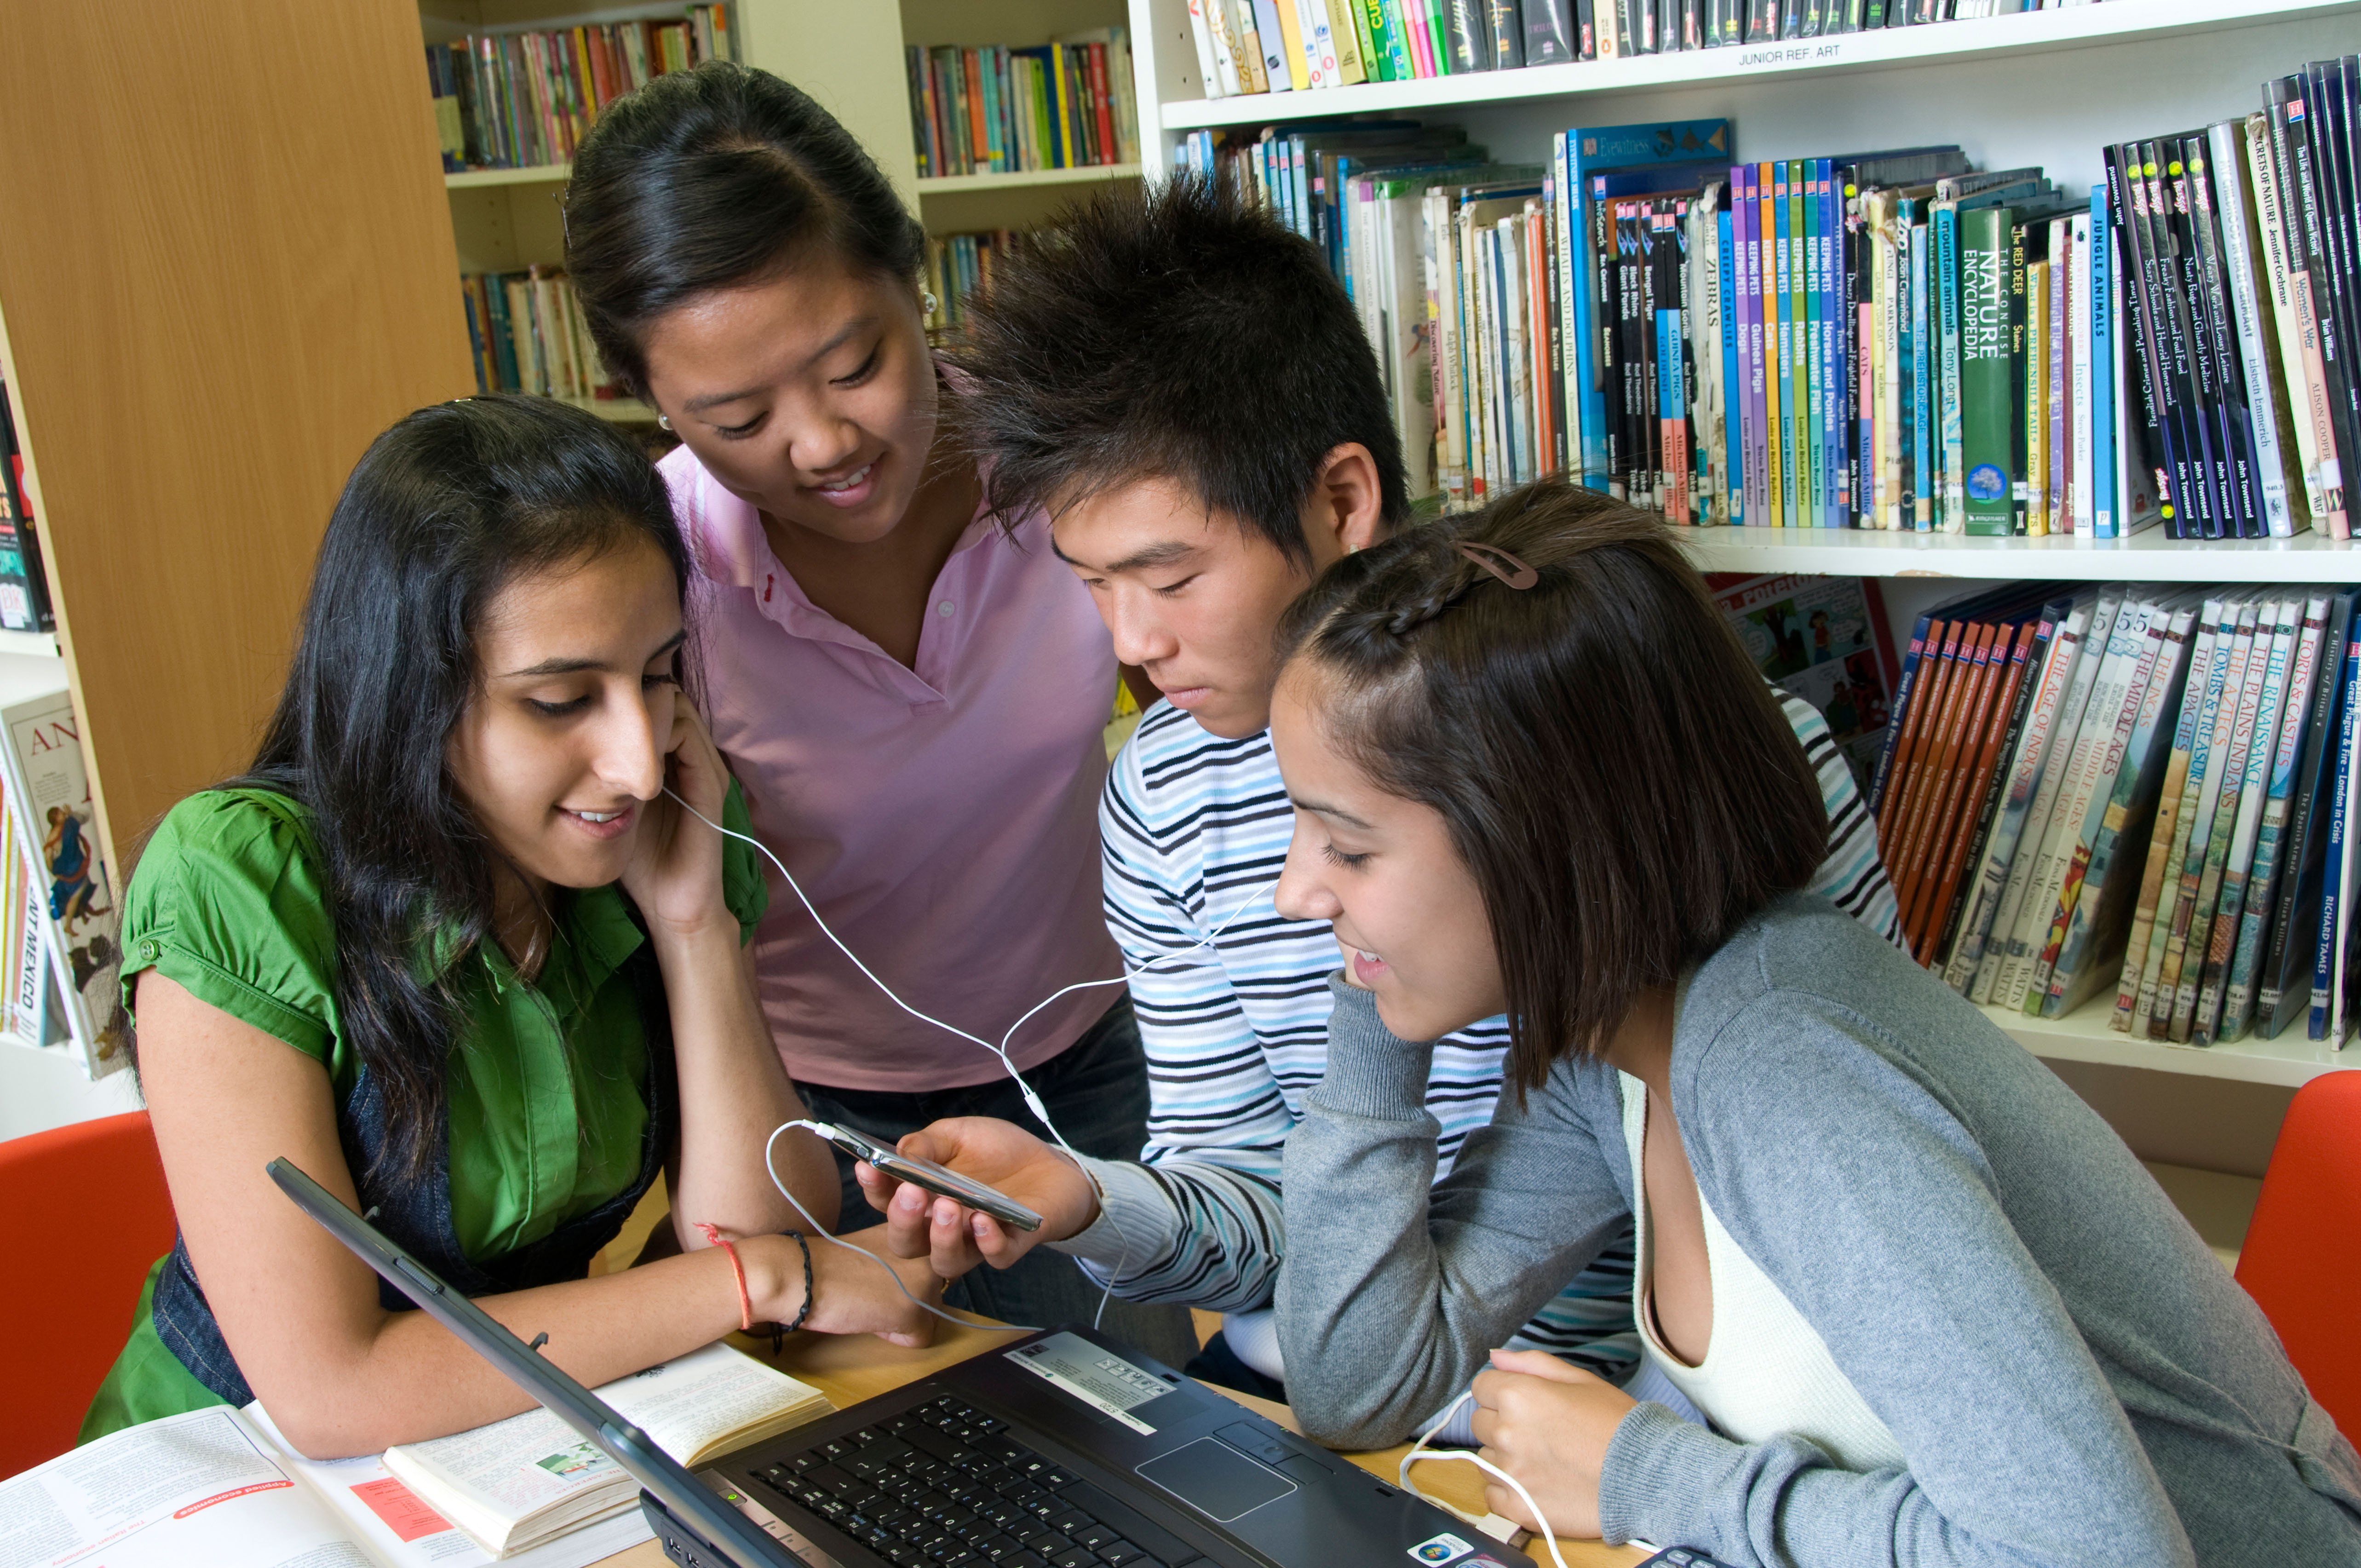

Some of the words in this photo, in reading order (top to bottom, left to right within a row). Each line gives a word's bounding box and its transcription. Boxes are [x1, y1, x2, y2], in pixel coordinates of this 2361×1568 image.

[1739, 51, 1782, 66] JUNIOR
[1787, 48, 1813, 61] REF.
[1816, 45, 1840, 57] ART
[2311, 111, 2321, 147] HEINEMANN
[1569, 139, 1579, 183] EYEWITNESS
[1601, 138, 1649, 160] Eyewitness
[2108, 166, 2120, 207] Townsend
[2260, 172, 2271, 186] OF
[1571, 184, 1580, 210] SHARK
[2263, 187, 2276, 225] NATURE
[2115, 208, 2124, 225] John
[1896, 216, 1911, 251] Zoo
[2094, 220, 2102, 270] JUNGLE
[2269, 229, 2281, 265] Jennifer
[2309, 233, 2319, 256] Victoria
[1560, 236, 1570, 280] WHALES
[1722, 240, 1730, 283] CREEPY
[1735, 241, 1745, 275] KEEPING
[1748, 241, 1759, 275] KEEPING
[1899, 255, 1908, 276] Joan
[1942, 221, 1953, 282] mountain
[1999, 248, 2008, 277] THE
[2013, 247, 2023, 266] RED
[1620, 265, 1628, 289] Giant
[1644, 265, 1652, 297] Bengal
[1679, 264, 1689, 306] Mountain
[1736, 276, 1746, 295] PETS
[1750, 276, 1760, 295] PETS
[2013, 269, 2023, 295] DEER
[2145, 258, 2154, 283] Scary
[2184, 257, 2195, 283] Nasty
[2274, 265, 2287, 307] Cochrane
[1562, 285, 1571, 312] AND
[1630, 289, 1638, 317] Rhino
[1707, 258, 1718, 327] ZEBRAS
[2029, 273, 2037, 301] What
[2128, 280, 2139, 307] Times
[2149, 283, 2161, 314] Schools
[2188, 284, 2199, 303] Bugs
[2296, 277, 2313, 327] Women's
[1620, 291, 1629, 321] Panda
[1645, 298, 1654, 322] Tiger
[1723, 289, 1733, 348] CRAWLIES
[1899, 279, 1910, 333] Crammond
[1945, 286, 1955, 335] animals
[1964, 249, 1977, 361] ENCYCLOPEDIA
[1979, 252, 1999, 359] NATURE
[2095, 276, 2104, 337] ANIMALS
[2238, 286, 2254, 337] GERMANY
[1681, 308, 1689, 339] Gorilla
[1737, 323, 1747, 354] Dogs
[1765, 323, 1775, 350] Cats
[1916, 328, 1925, 345] THE
[1999, 289, 2009, 359] CONCISE
[2013, 325, 2023, 353] Staines
[2132, 307, 2145, 346] Punishing
[2195, 321, 2207, 355] Ghastly
[2302, 327, 2314, 350] War
[1563, 316, 1574, 376] DOLPHINS
[1671, 329, 1680, 371] GUINEA
[1751, 323, 1762, 365] Guinea
[1779, 322, 1789, 378] Hamsters
[1794, 322, 1805, 366] Rabbits
[1809, 321, 1820, 386] Freshwater
[1822, 321, 1833, 364] Horses
[1946, 345, 1956, 372] Tony
[2156, 330, 2170, 360] Horrid
[1752, 368, 1763, 394] Pigs
[1823, 367, 1834, 389] and
[1917, 348, 1926, 414] PREHISTORIC
[2029, 329, 2038, 406] PREHENSILE
[2161, 360, 2176, 406] Homework
[2199, 355, 2210, 394] Medicine
[2249, 359, 2260, 395] Elsbeth
[1946, 375, 1956, 405] Long
[2075, 363, 2086, 406] Insects
[2312, 383, 2323, 418] ALISON
[1810, 390, 1821, 415] Fish
[1824, 392, 1835, 431] Ponies
[2145, 394, 2158, 427] Fiendish
[1918, 416, 1926, 433] AGE
[2254, 396, 2272, 448] Emmerich
[2317, 420, 2331, 460] COOPER
[2238, 460, 2247, 478] John
[2240, 480, 2254, 518] Townsend
[1, 588, 23, 610] DK
[2055, 652, 2070, 679] THE
[2137, 650, 2156, 680] THE
[2152, 655, 2172, 685] THE
[2190, 648, 2209, 678] THE
[2209, 647, 2230, 697] TOMBS
[2227, 648, 2247, 678] THE
[2248, 647, 2268, 678] THE
[2267, 648, 2286, 681] THE
[2293, 639, 2315, 684] FORTS
[2041, 681, 2060, 713] AGE
[2117, 681, 2144, 738] MIDDLE
[2139, 686, 2161, 729] INCAS
[2205, 698, 2218, 711] &
[2236, 680, 2260, 738] PLAINS
[2290, 688, 2303, 700] &
[2348, 681, 2357, 705] Great
[2034, 714, 2050, 732] OF
[2176, 681, 2200, 752] APACHES
[2213, 682, 2238, 747] AZTECS
[2343, 706, 2355, 735] Plague
[2188, 710, 2216, 789] TREASURE
[2245, 684, 2279, 788] RENAISSANCE
[2277, 703, 2301, 767] CASTLES
[2103, 737, 2124, 776] AGES
[2340, 747, 2350, 764] Fire
[2220, 741, 2247, 808] INDIANS
[2336, 775, 2349, 804] London
[2300, 792, 2310, 807] The
[2293, 809, 2308, 843] Spanish
[2332, 819, 2344, 844] Crisis
[2289, 844, 2301, 874] Armada
[2319, 896, 2334, 940] RICHARD
[2317, 941, 2330, 974] TAMES
[23, 939, 37, 1010] MEXICO
[1099, 1402, 1119, 1414] 5720
[244, 1480, 287, 1493] Applied
[180, 1491, 241, 1516] economics
